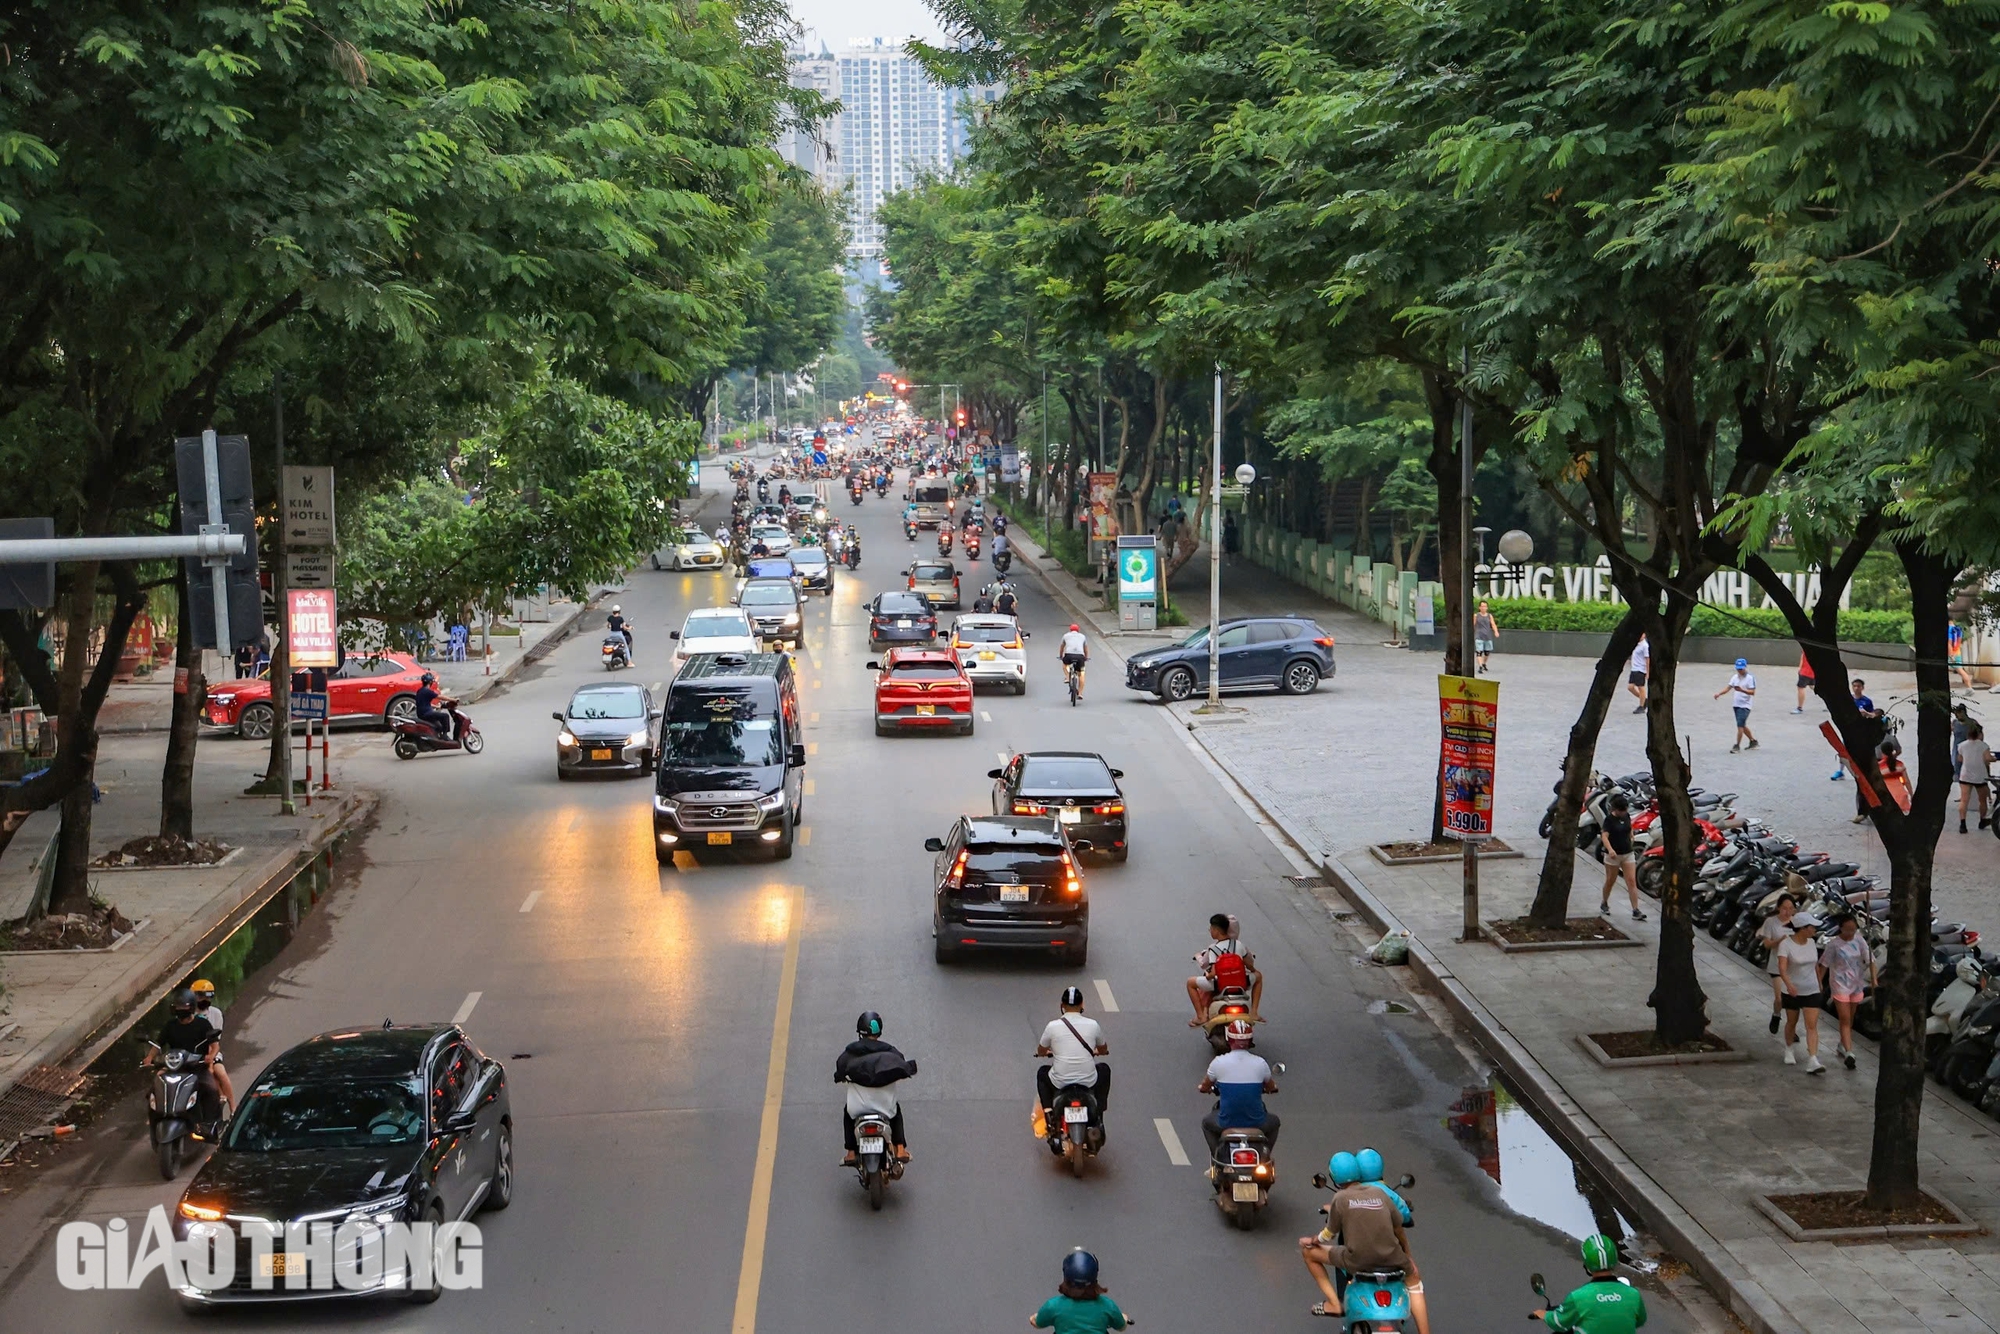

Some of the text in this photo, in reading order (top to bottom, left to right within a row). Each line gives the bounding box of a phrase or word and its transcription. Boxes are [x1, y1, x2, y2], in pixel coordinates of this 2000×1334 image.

[289, 500, 312, 508] KIM
[290, 511, 328, 520] HOTEL
[1473, 553, 1555, 601] CÔNG
[296, 597, 327, 606] Mai Villa
[291, 612, 332, 633] HOTEL
[293, 637, 332, 646] MAI VILLA
[1596, 1292, 1622, 1302] Grab
